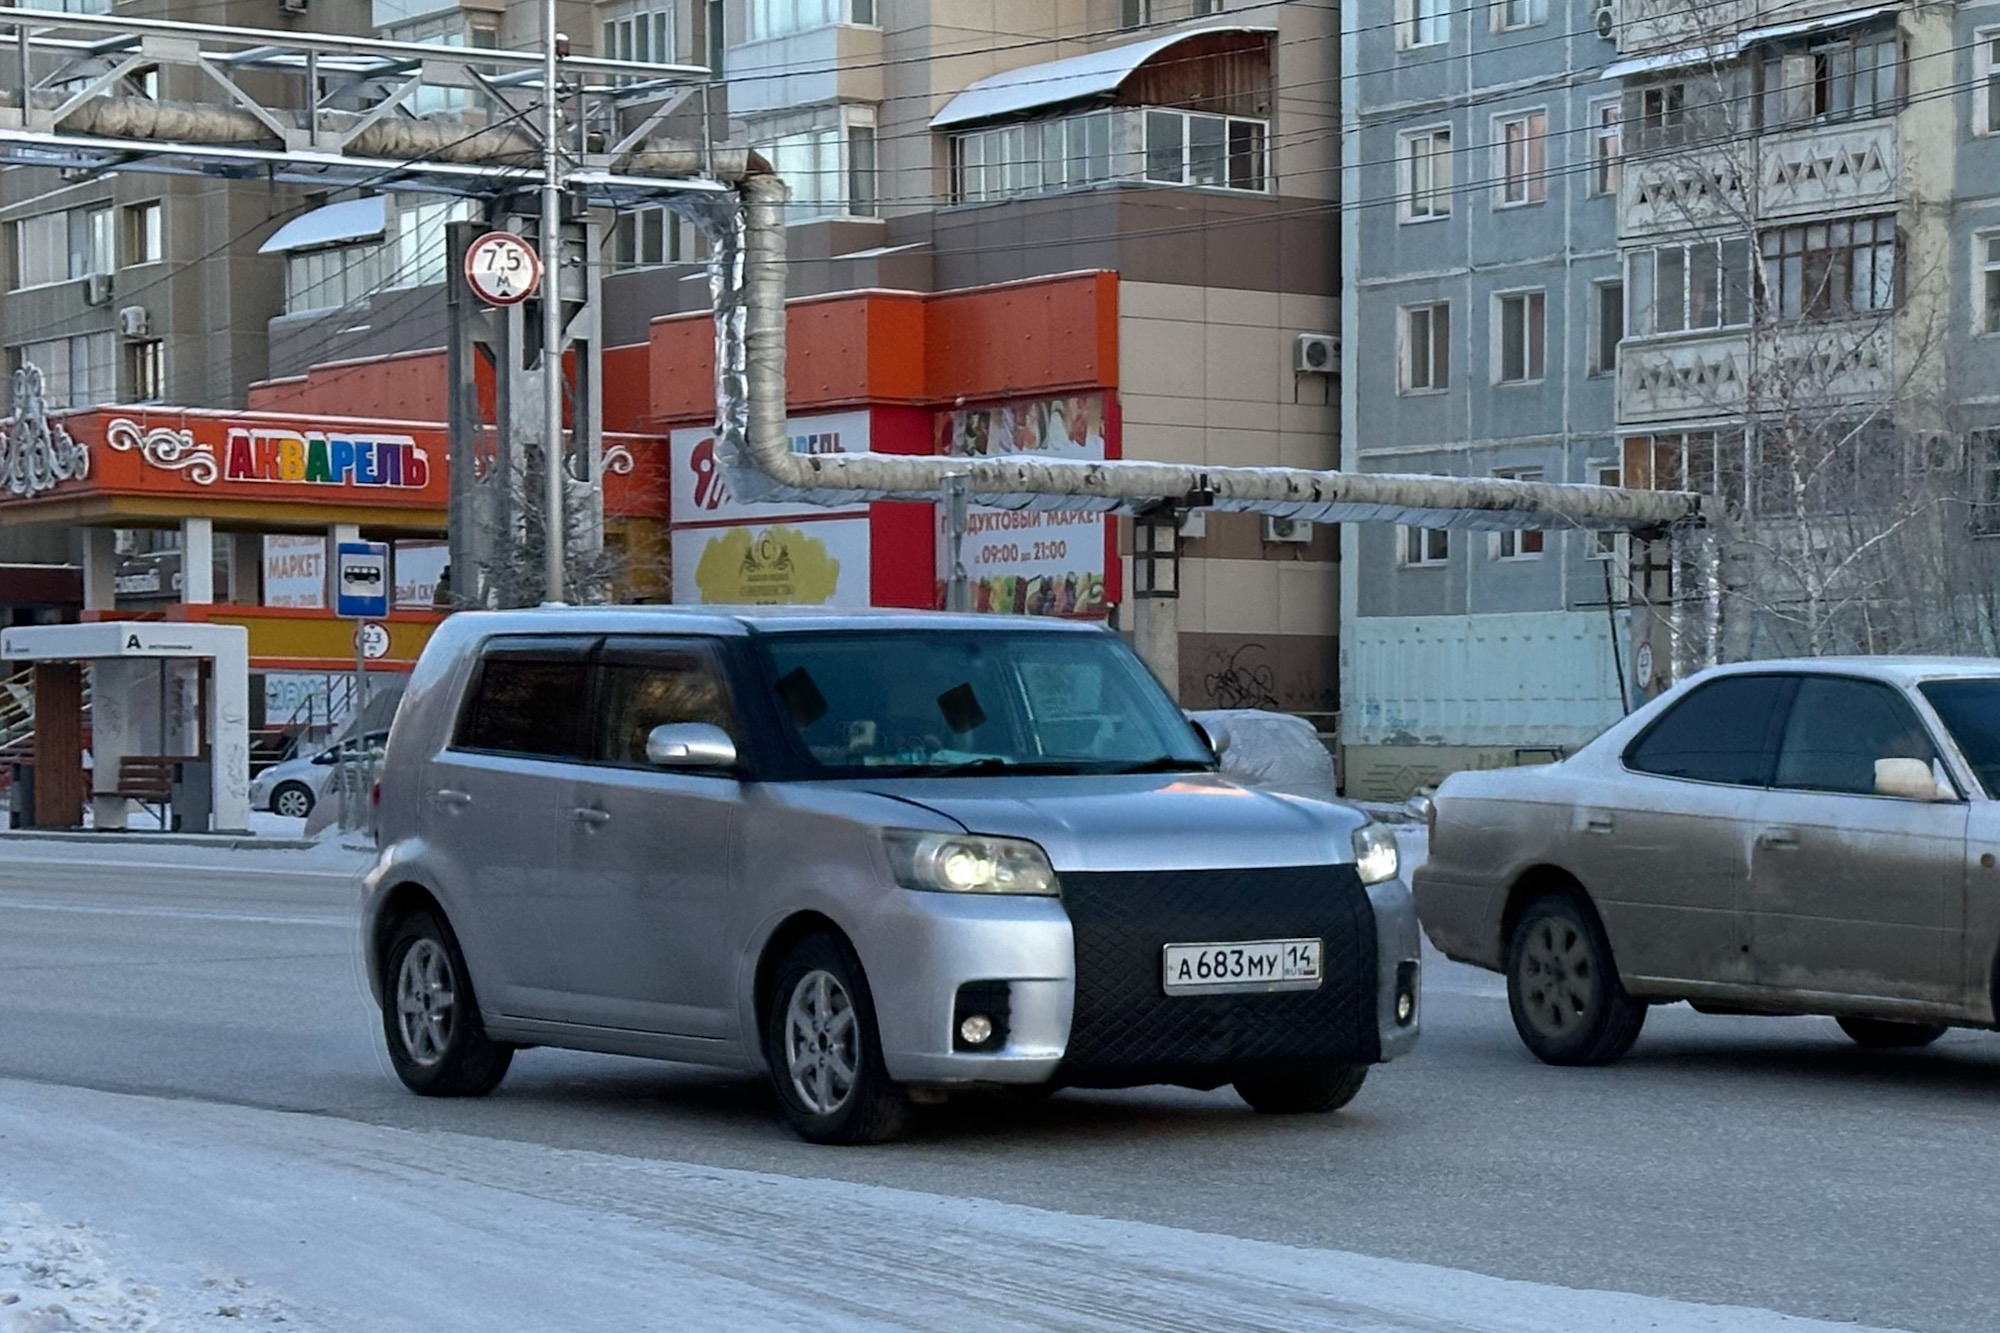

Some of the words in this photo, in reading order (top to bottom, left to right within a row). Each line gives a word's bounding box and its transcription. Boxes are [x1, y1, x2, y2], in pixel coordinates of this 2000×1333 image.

[482, 248, 521, 275] 7,5
[226, 434, 428, 488] АКВАРЕЛЬ
[982, 543, 1018, 563] 09:00
[1033, 540, 1067, 560] 21:00
[268, 553, 321, 579] МАРКЕТ
[126, 634, 142, 649] А
[1178, 949, 1278, 980] А683МУ
[1288, 946, 1311, 967] 14
